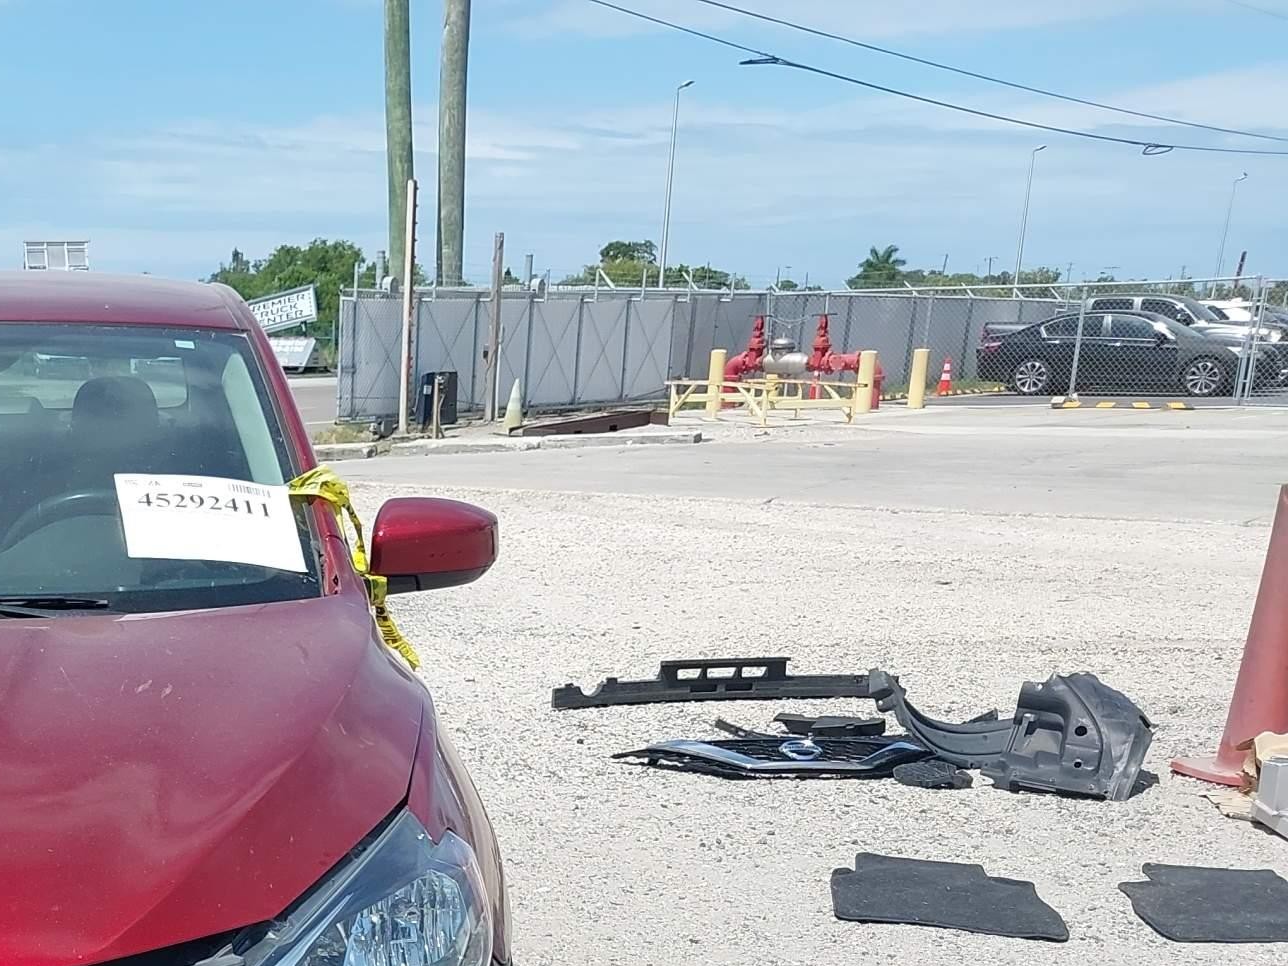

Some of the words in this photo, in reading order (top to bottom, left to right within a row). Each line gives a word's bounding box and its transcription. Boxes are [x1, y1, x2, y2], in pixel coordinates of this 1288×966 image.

[252, 293, 305, 312] REMIER
[258, 309, 304, 325] ENTER
[138, 492, 270, 517] 45292411
